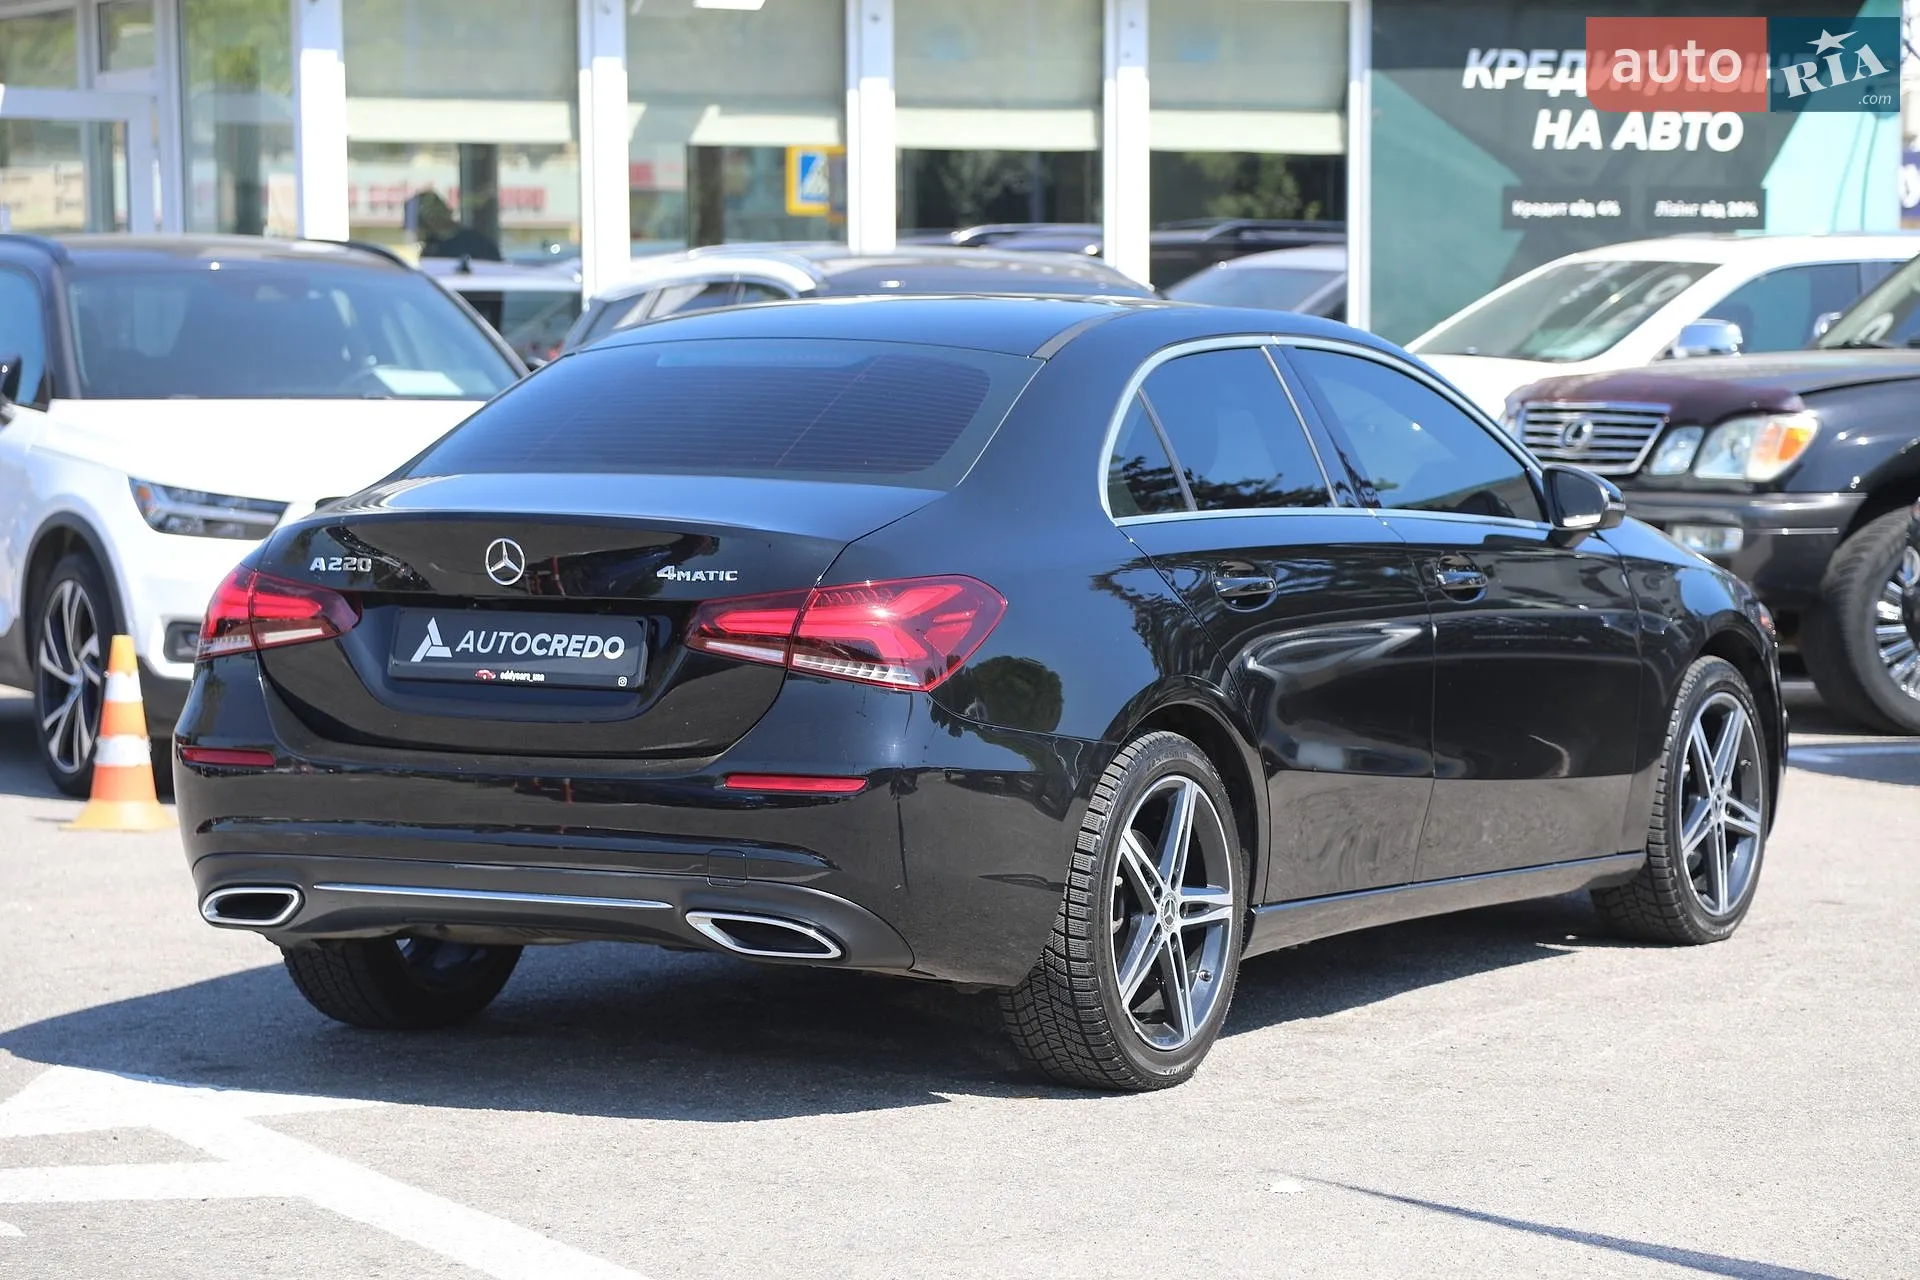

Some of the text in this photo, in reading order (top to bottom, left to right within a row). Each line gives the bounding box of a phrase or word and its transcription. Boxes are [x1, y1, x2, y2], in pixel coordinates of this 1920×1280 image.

[1533, 109, 1744, 151] НА АВТО
[1512, 200, 1567, 218] Кредит
[656, 565, 738, 582] 4MATIC
[455, 630, 625, 660] AUTOCREDO
